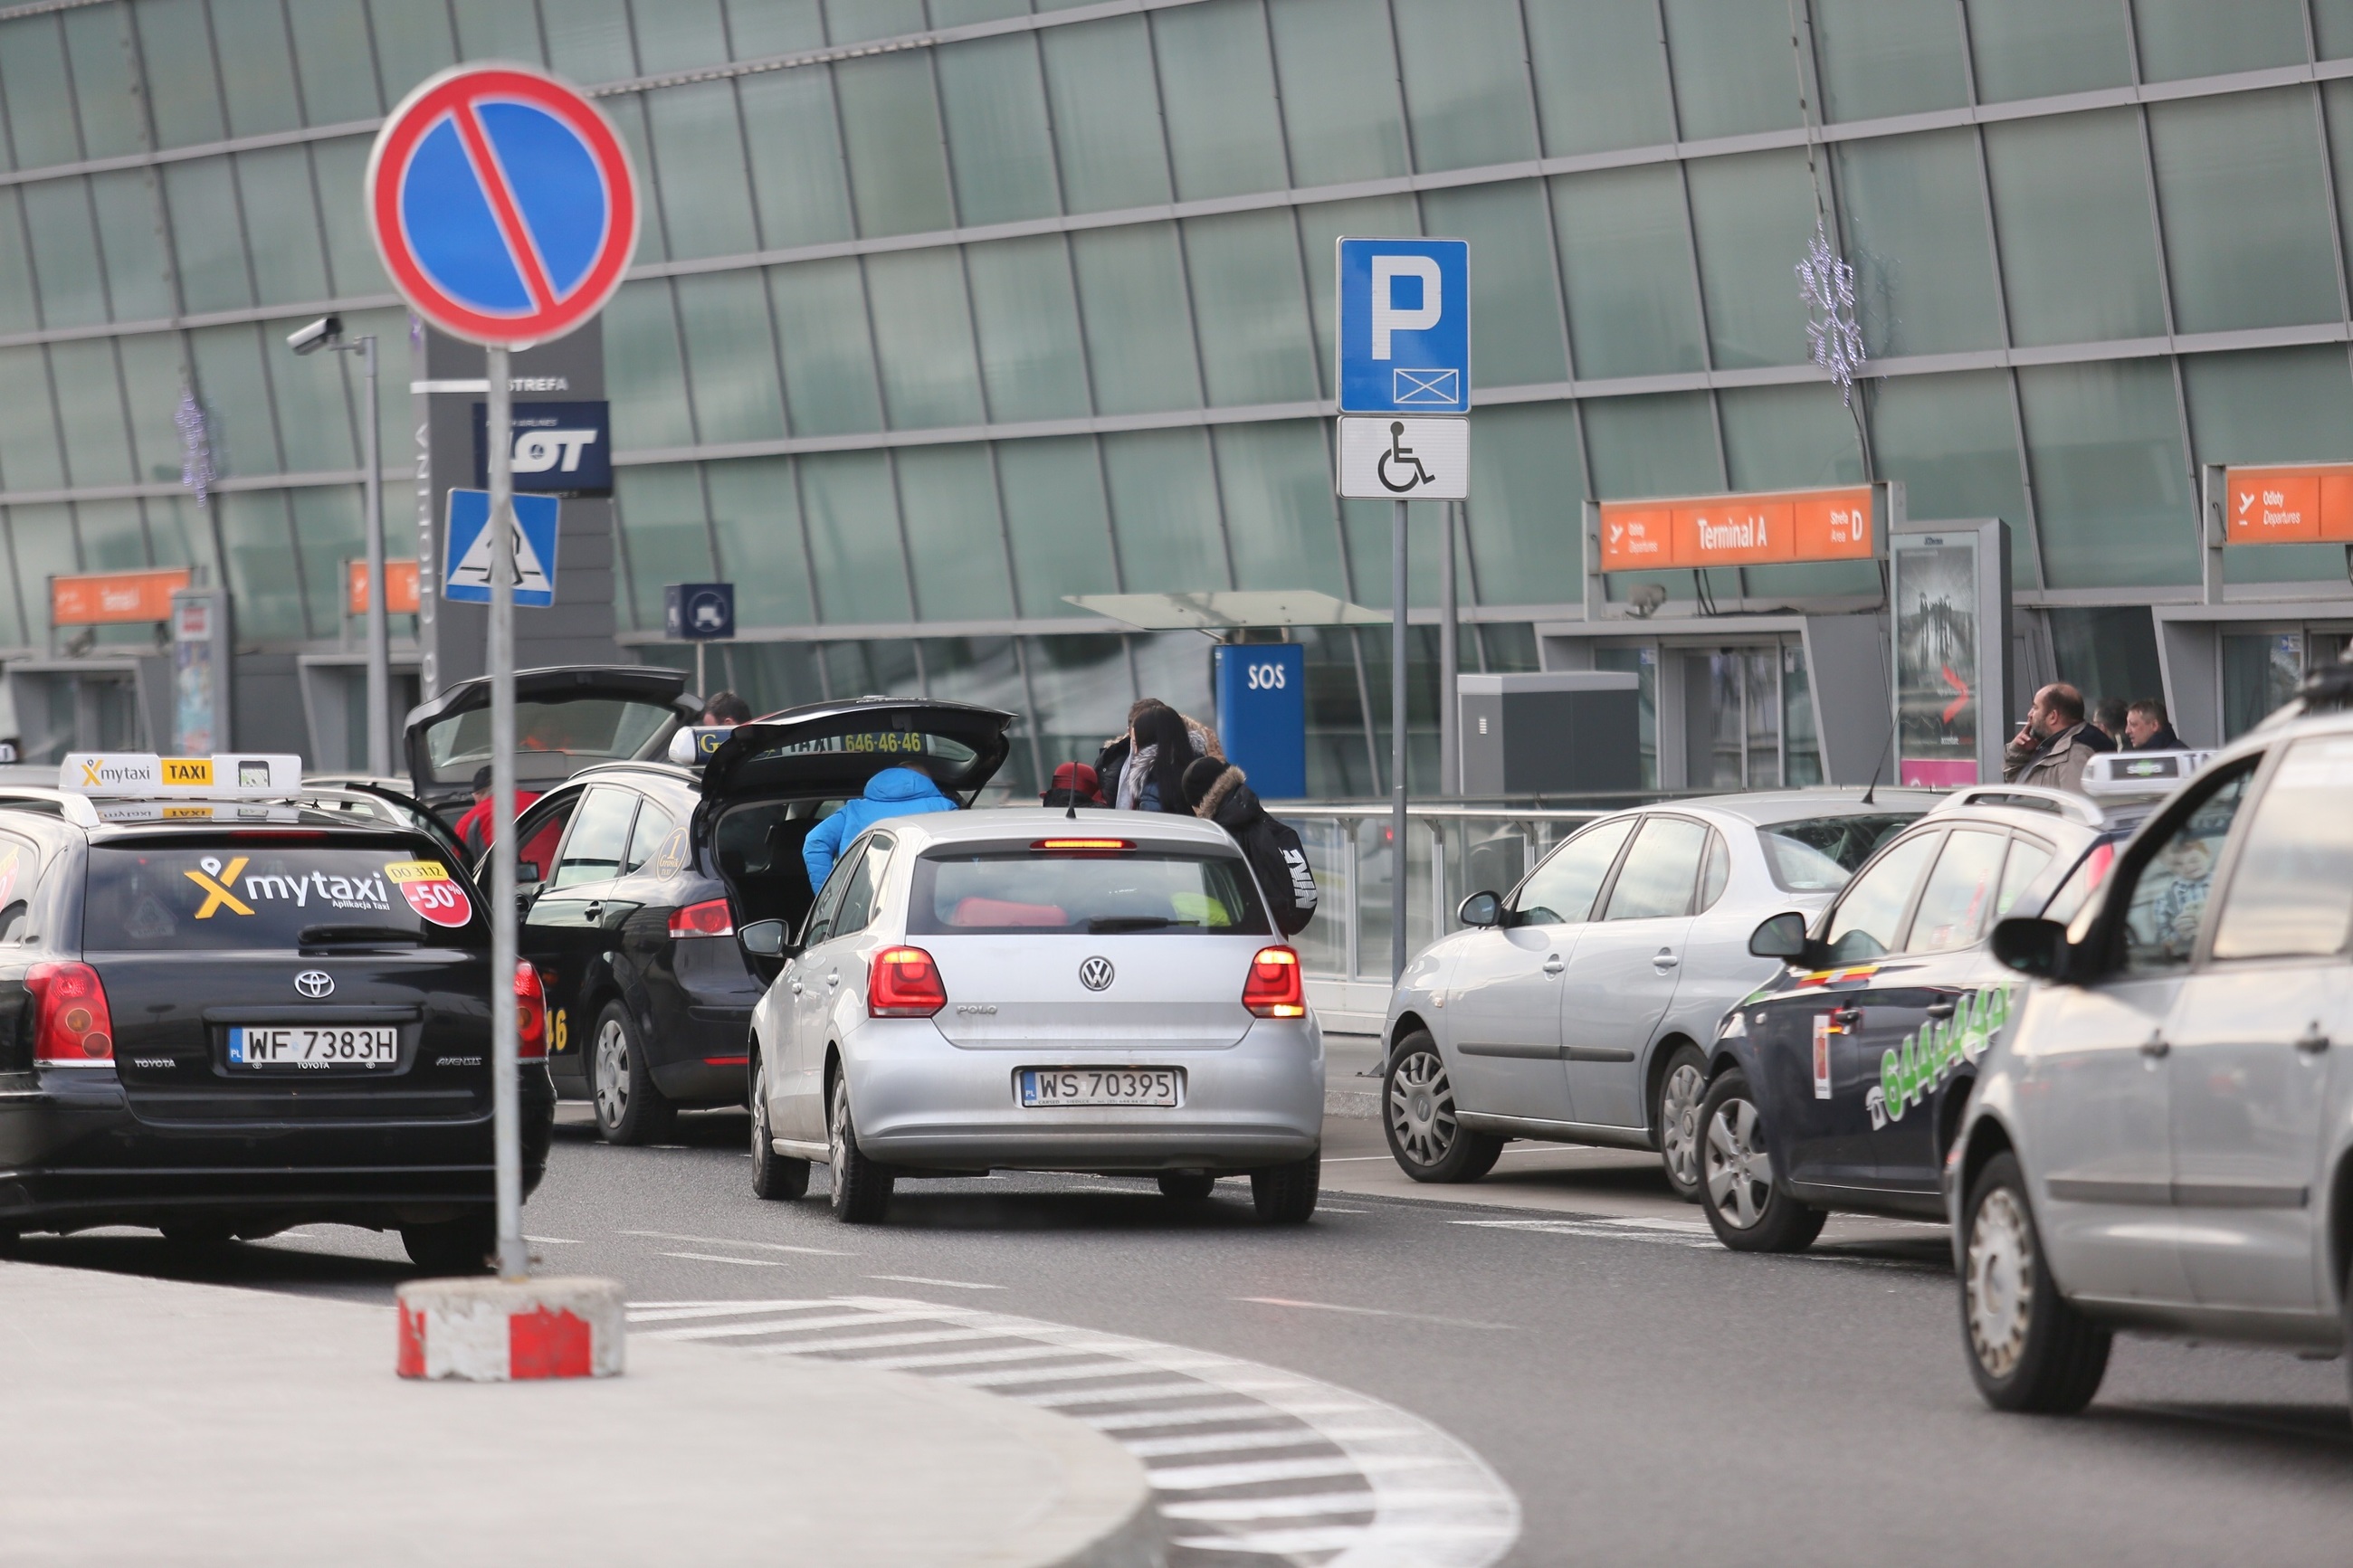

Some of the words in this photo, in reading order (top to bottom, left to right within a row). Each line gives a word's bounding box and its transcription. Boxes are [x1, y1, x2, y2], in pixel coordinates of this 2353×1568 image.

[1372, 255, 1442, 360] P
[1830, 510, 1849, 526] Strefa
[1852, 509, 1863, 541] D
[1697, 516, 1754, 550] Terminal
[1758, 516, 1767, 547] A
[1831, 529, 1846, 543] Area
[1248, 664, 1285, 689] SOS
[100, 765, 150, 784] mytaxi
[169, 765, 206, 780] TAXI
[391, 868, 411, 879] DO
[1281, 849, 1318, 909] NIKE
[244, 870, 388, 908] mytaxi
[332, 899, 372, 910] Aplikacja
[957, 1004, 998, 1015] POLO
[231, 1049, 242, 1059] PL
[249, 1031, 291, 1060] WF
[303, 1031, 394, 1060] 7383H
[134, 1058, 176, 1069] TOYOTA
[297, 1061, 330, 1069] TOYOTA
[1040, 1073, 1079, 1098] WS
[1088, 1073, 1170, 1098] 70395
